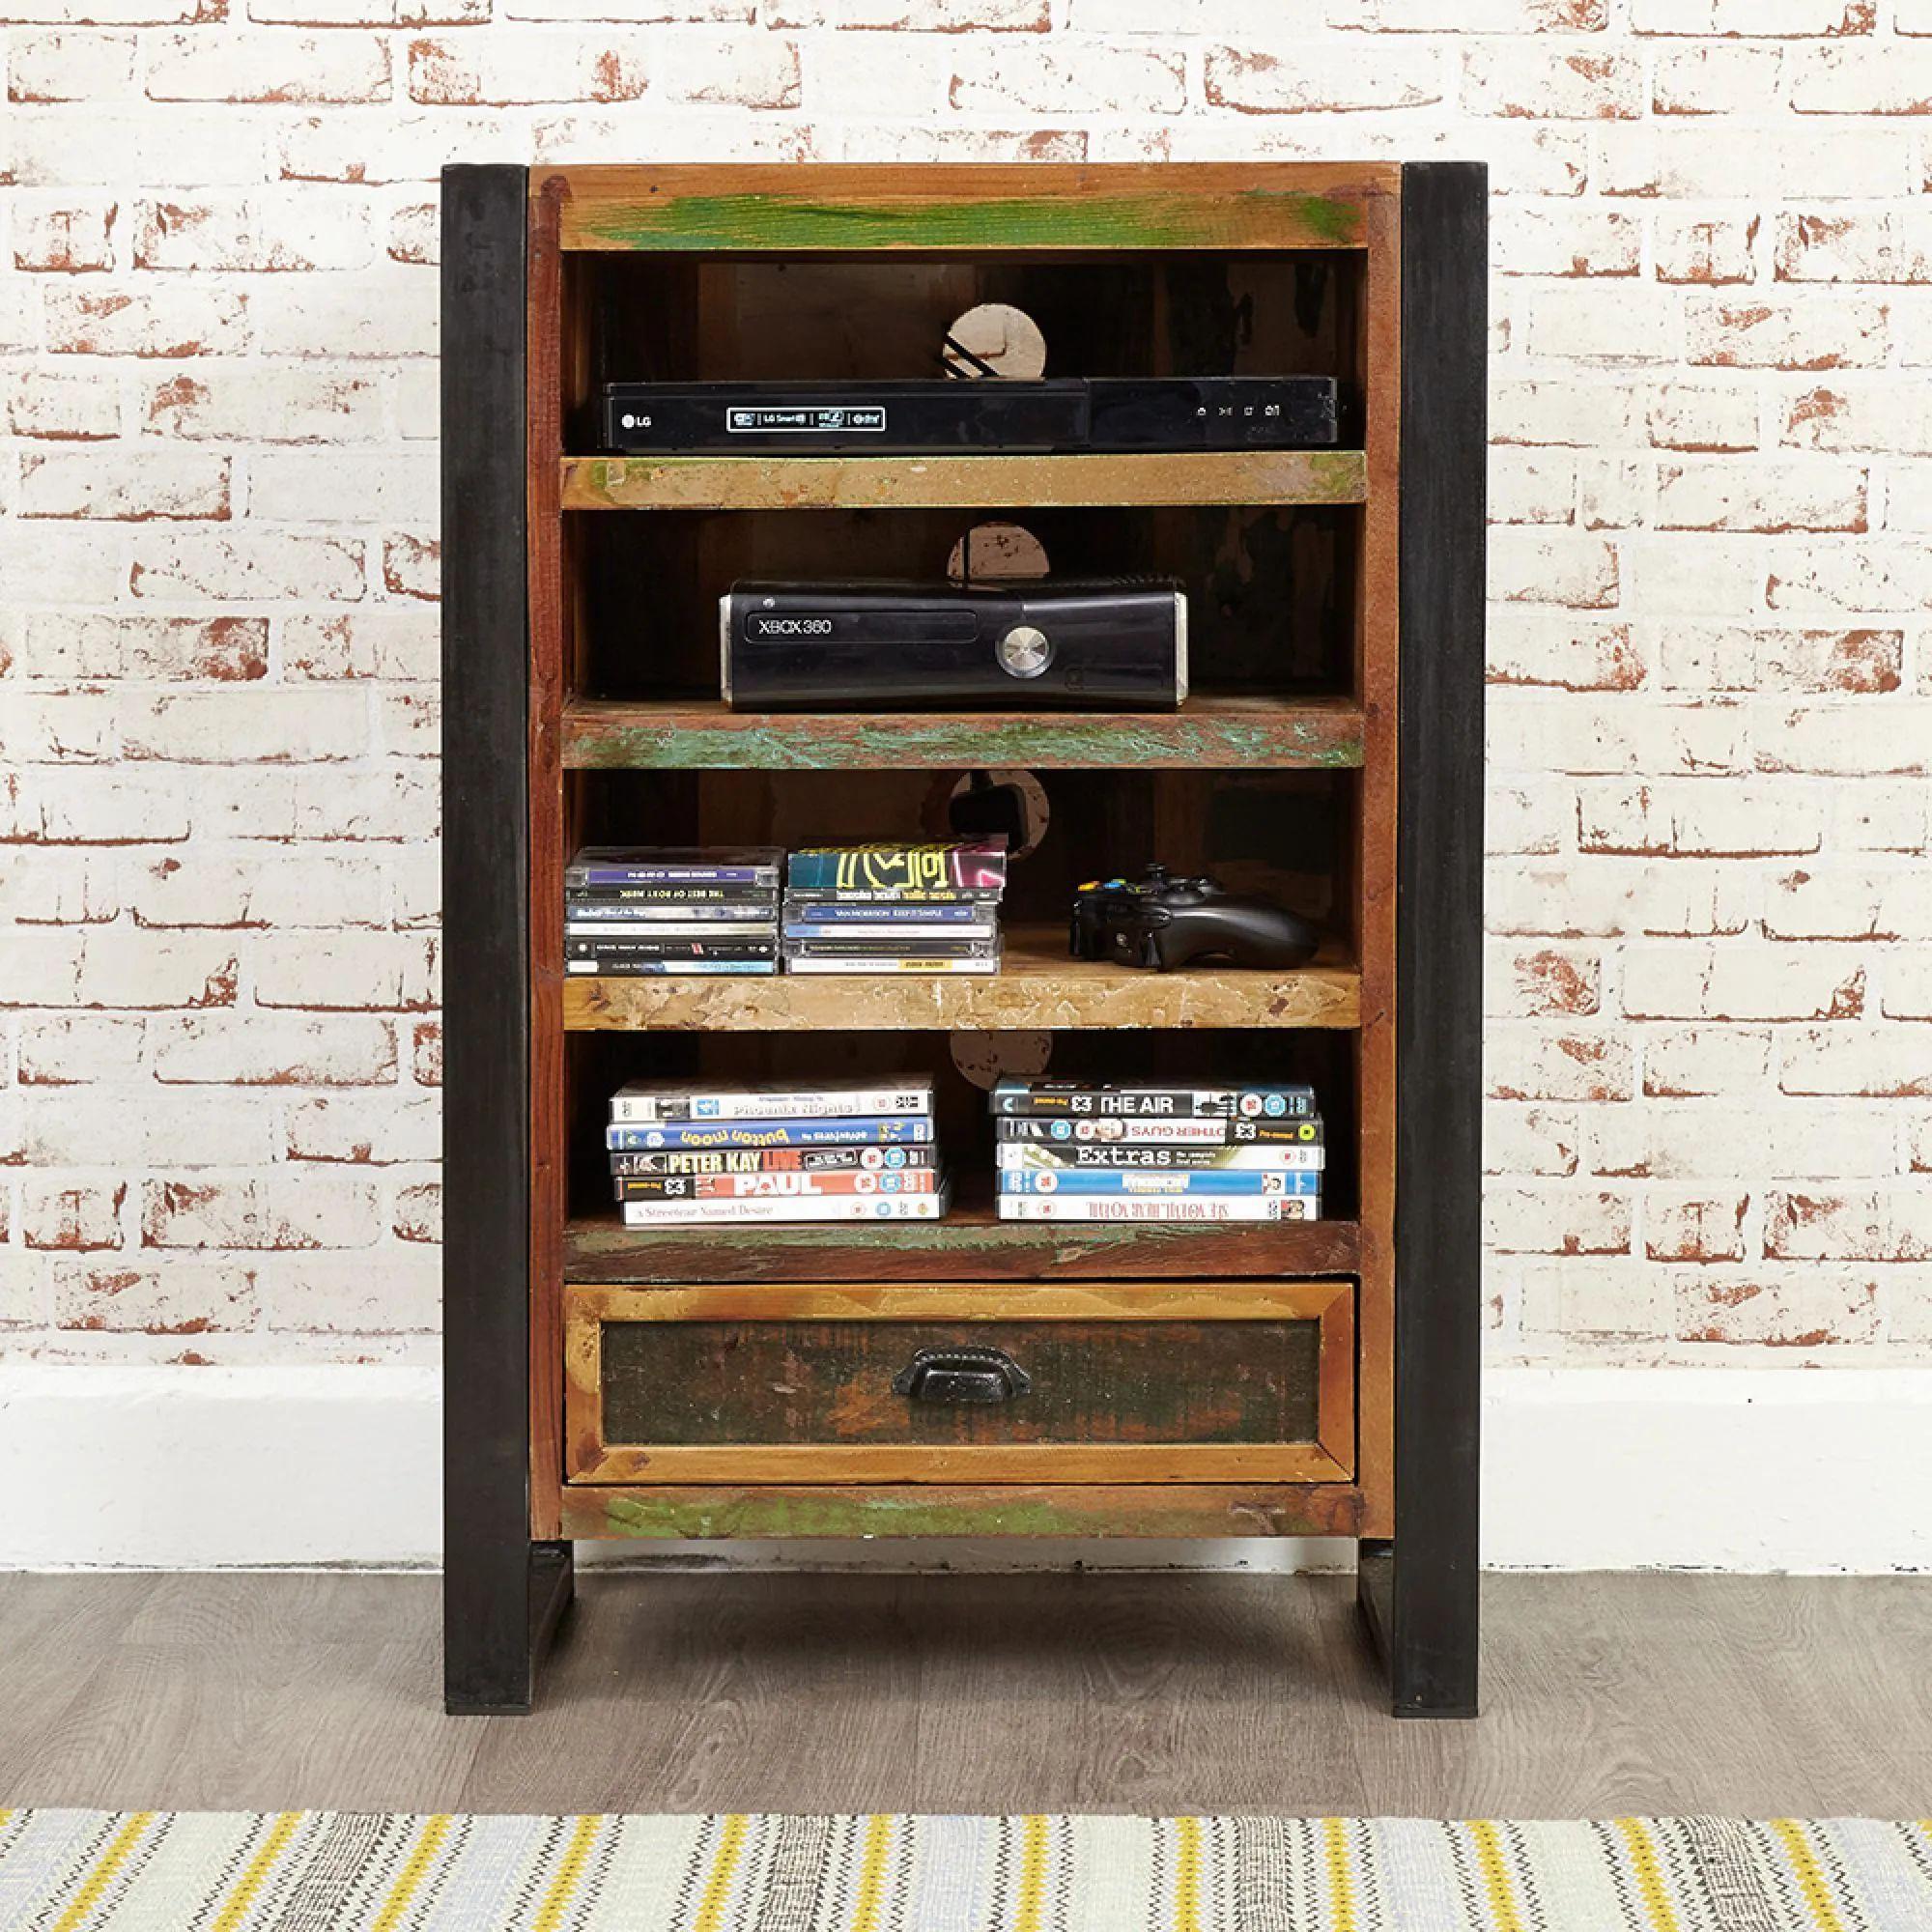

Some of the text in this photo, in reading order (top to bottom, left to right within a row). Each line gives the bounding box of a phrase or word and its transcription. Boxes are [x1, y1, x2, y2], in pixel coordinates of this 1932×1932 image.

[637, 416, 652, 427] LG
[758, 619, 832, 634] XBOX 360
[673, 890, 687, 898] OF
[688, 890, 707, 898] BEST
[709, 890, 724, 898] THE
[1140, 1097, 1174, 1113] AIR
[679, 1130, 729, 1146] moon
[731, 1128, 791, 1147] button
[1131, 1126, 1174, 1137] GUYS
[669, 1151, 723, 1173] PETER
[725, 1151, 760, 1172] KAY
[1076, 1147, 1172, 1165] Extras
[733, 1174, 822, 1196] PAUL
